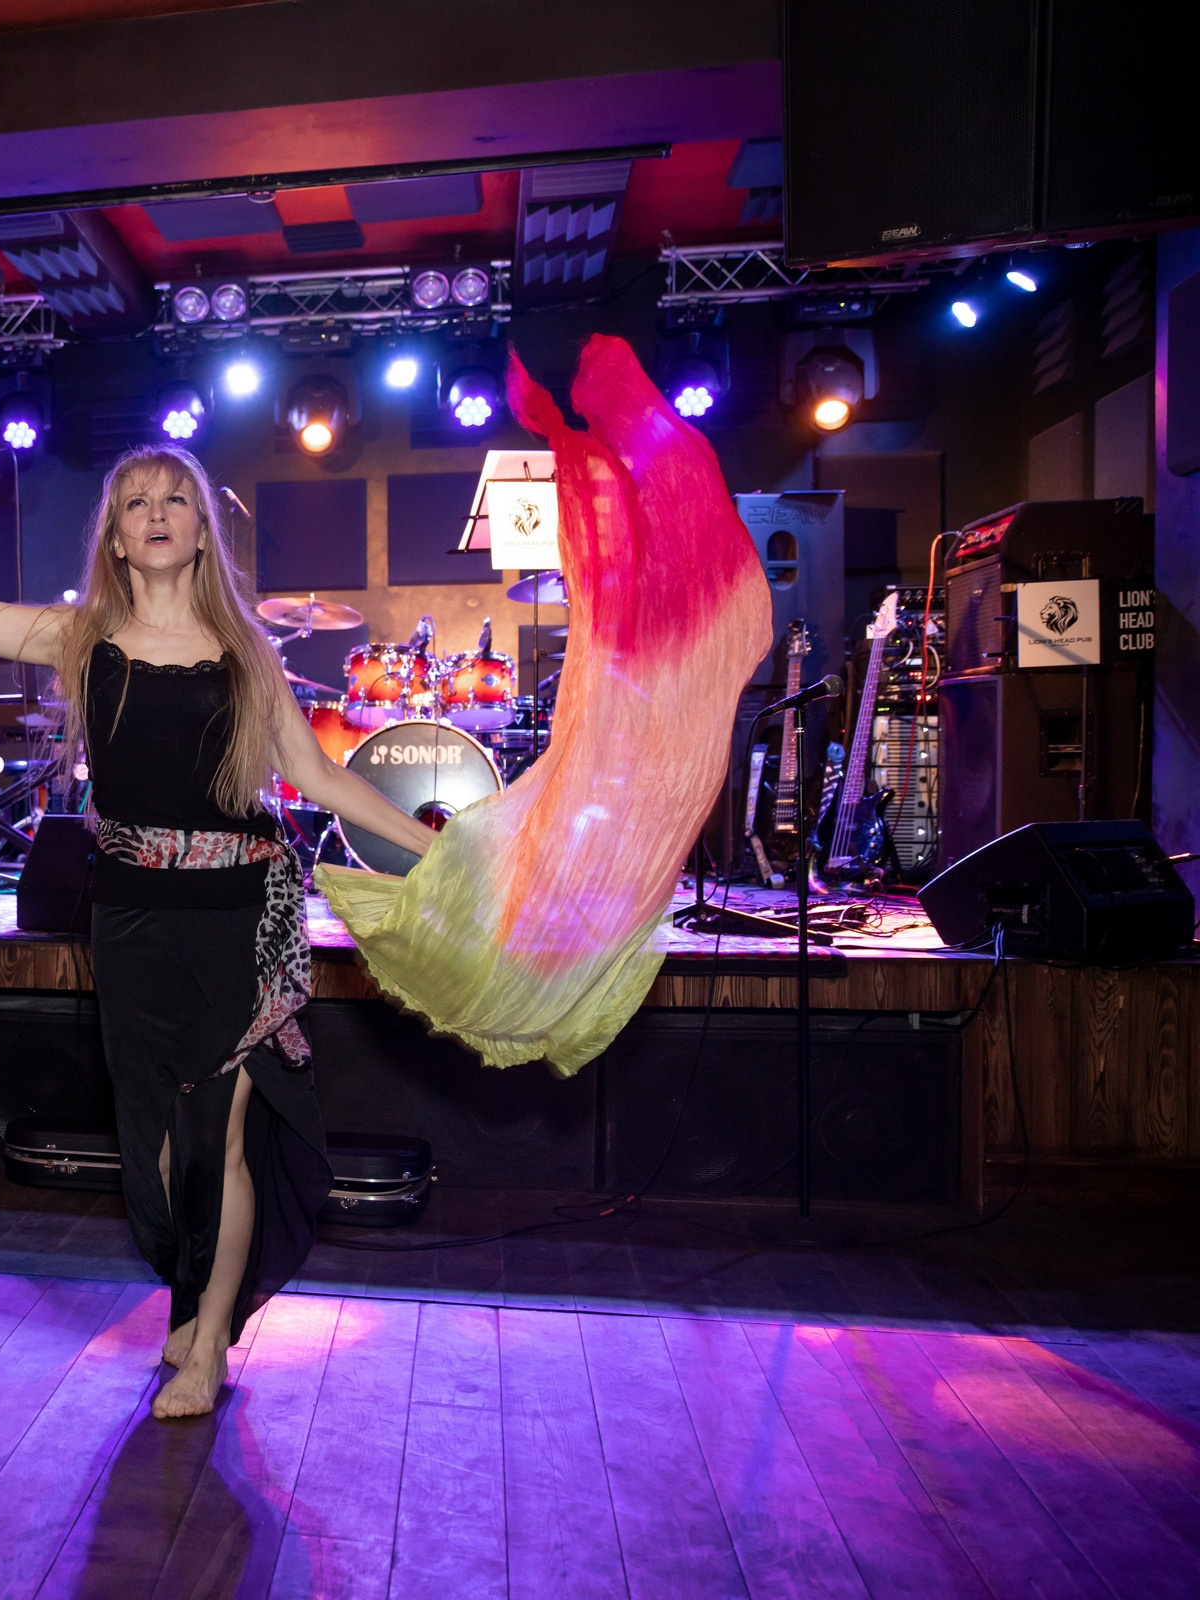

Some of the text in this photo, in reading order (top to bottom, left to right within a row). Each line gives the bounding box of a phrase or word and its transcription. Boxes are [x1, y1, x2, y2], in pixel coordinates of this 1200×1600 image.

[891, 224, 919, 238] EAW
[1119, 611, 1154, 629] HEAD
[1028, 638, 1053, 646] LION'S
[1119, 633, 1155, 651] CLUB
[390, 744, 462, 765] SONOR
